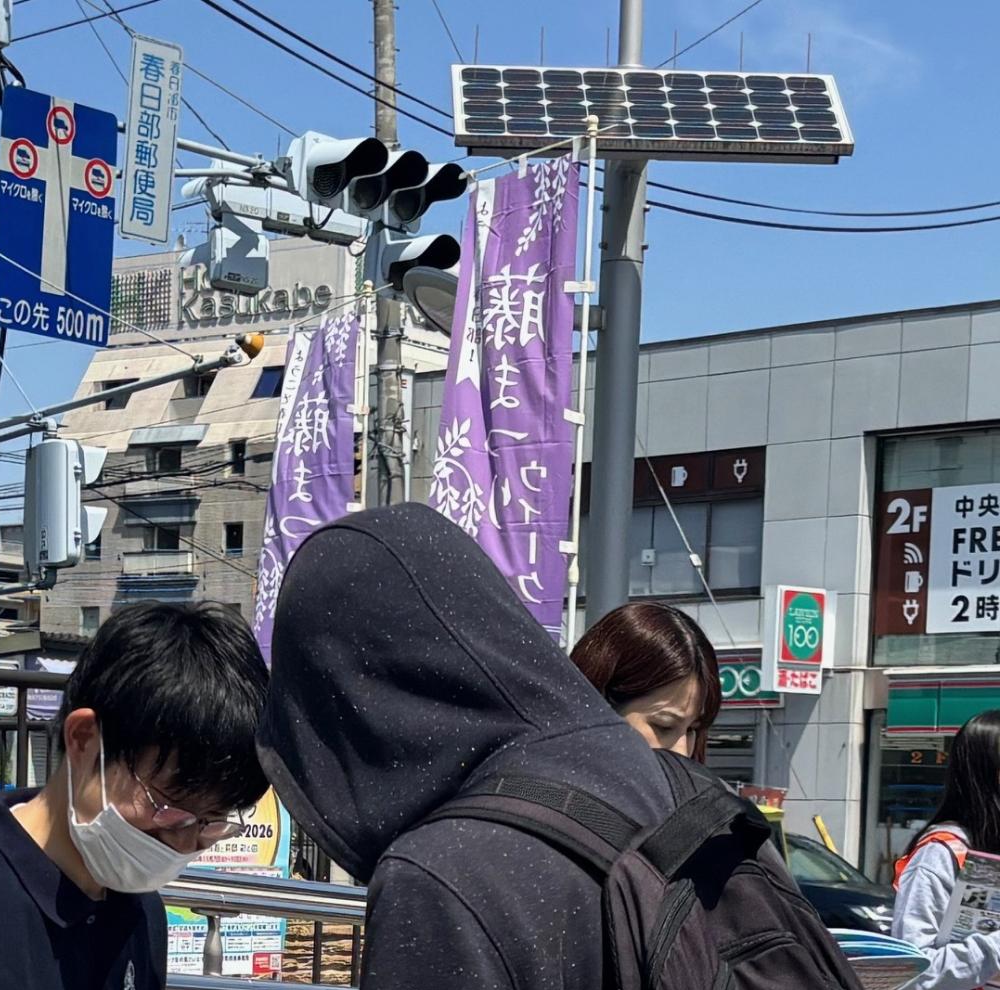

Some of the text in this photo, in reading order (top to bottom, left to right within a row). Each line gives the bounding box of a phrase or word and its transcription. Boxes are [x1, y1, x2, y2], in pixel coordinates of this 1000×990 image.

[129, 52, 166, 227] 春日部郵便局
[56, 305, 105, 342] 500m
[885, 497, 928, 535] 2F
[787, 624, 820, 648] 100
[244, 823, 274, 839] 2026
